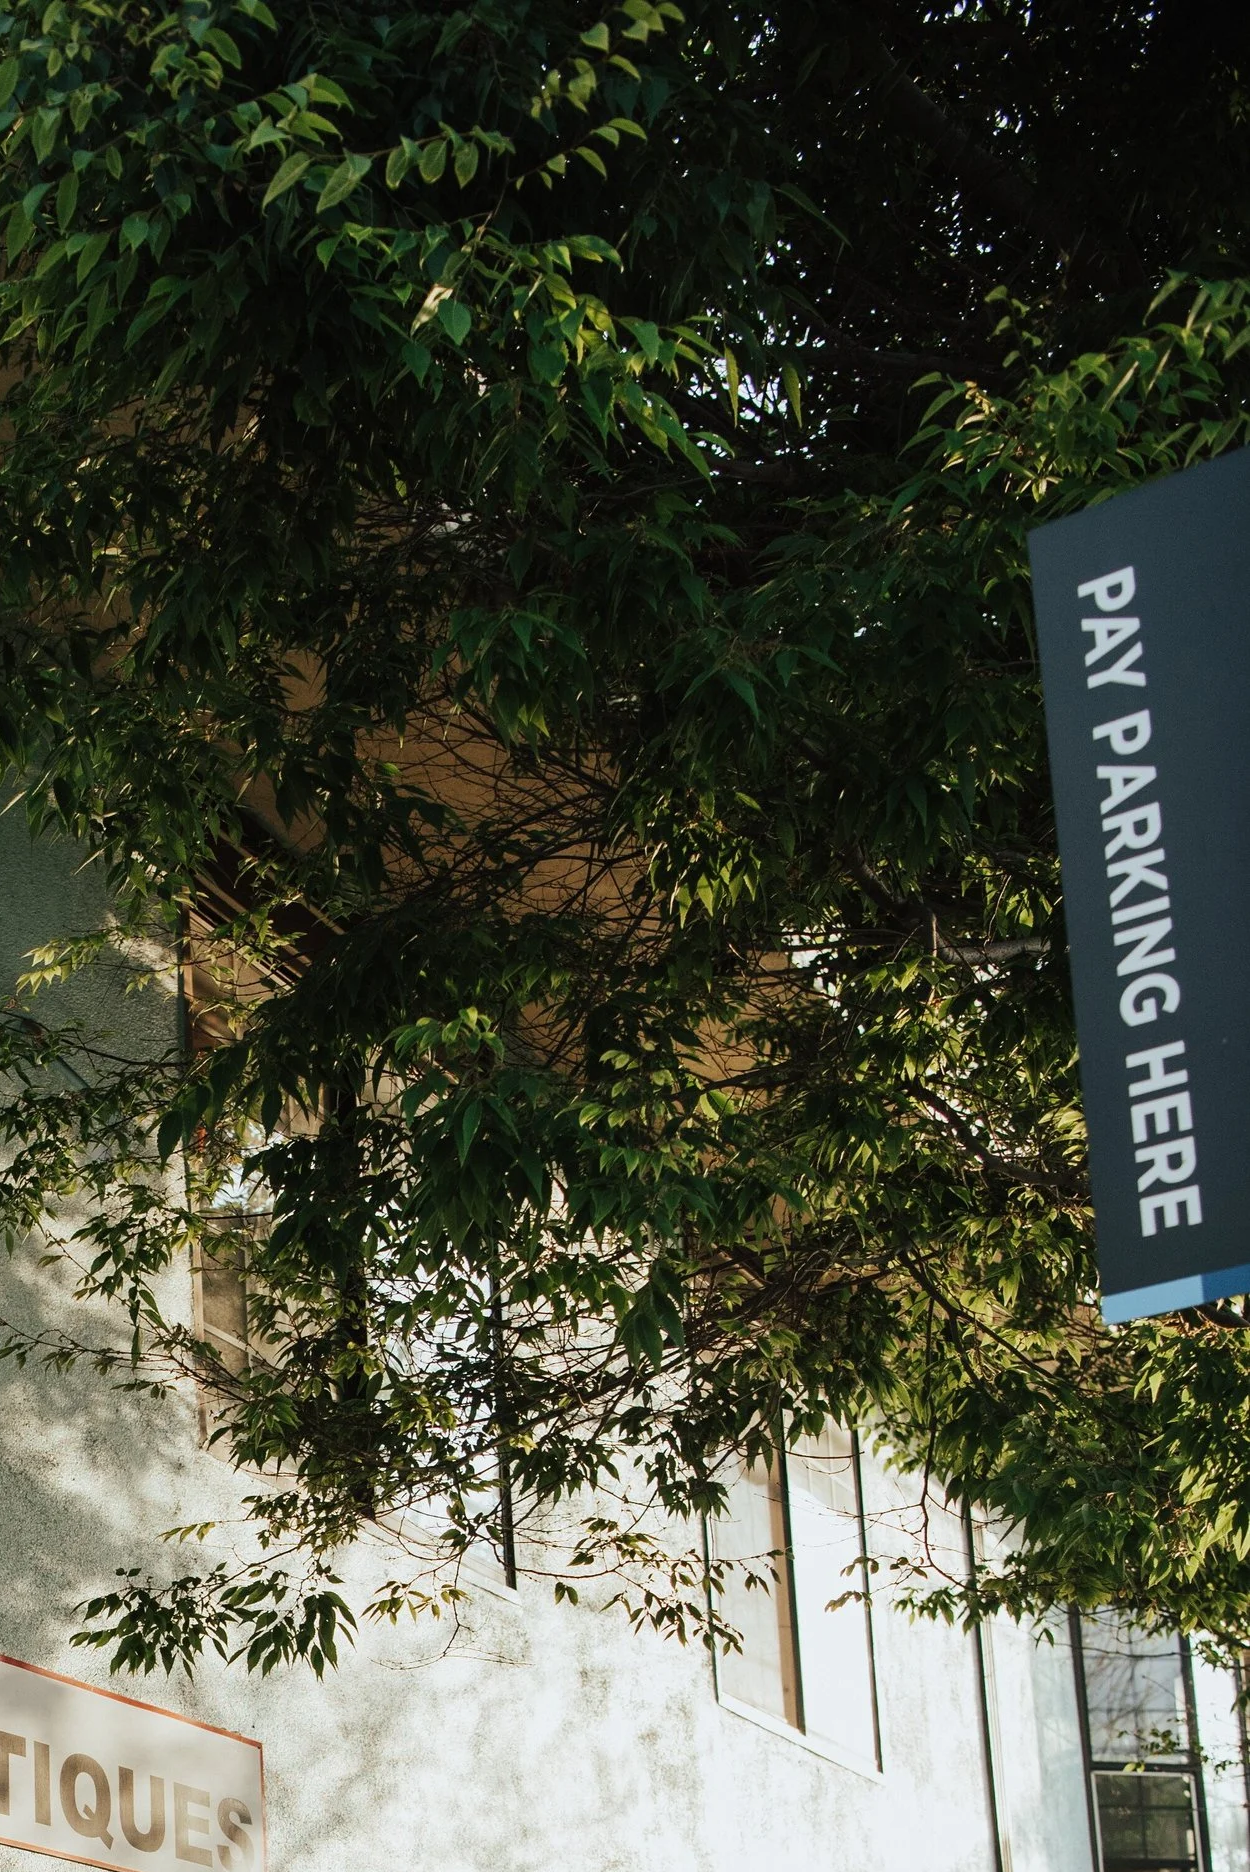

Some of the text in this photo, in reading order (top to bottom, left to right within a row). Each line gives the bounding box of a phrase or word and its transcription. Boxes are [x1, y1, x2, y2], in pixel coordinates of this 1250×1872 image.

[1077, 565, 1203, 1238] PAY PARKING HERE
